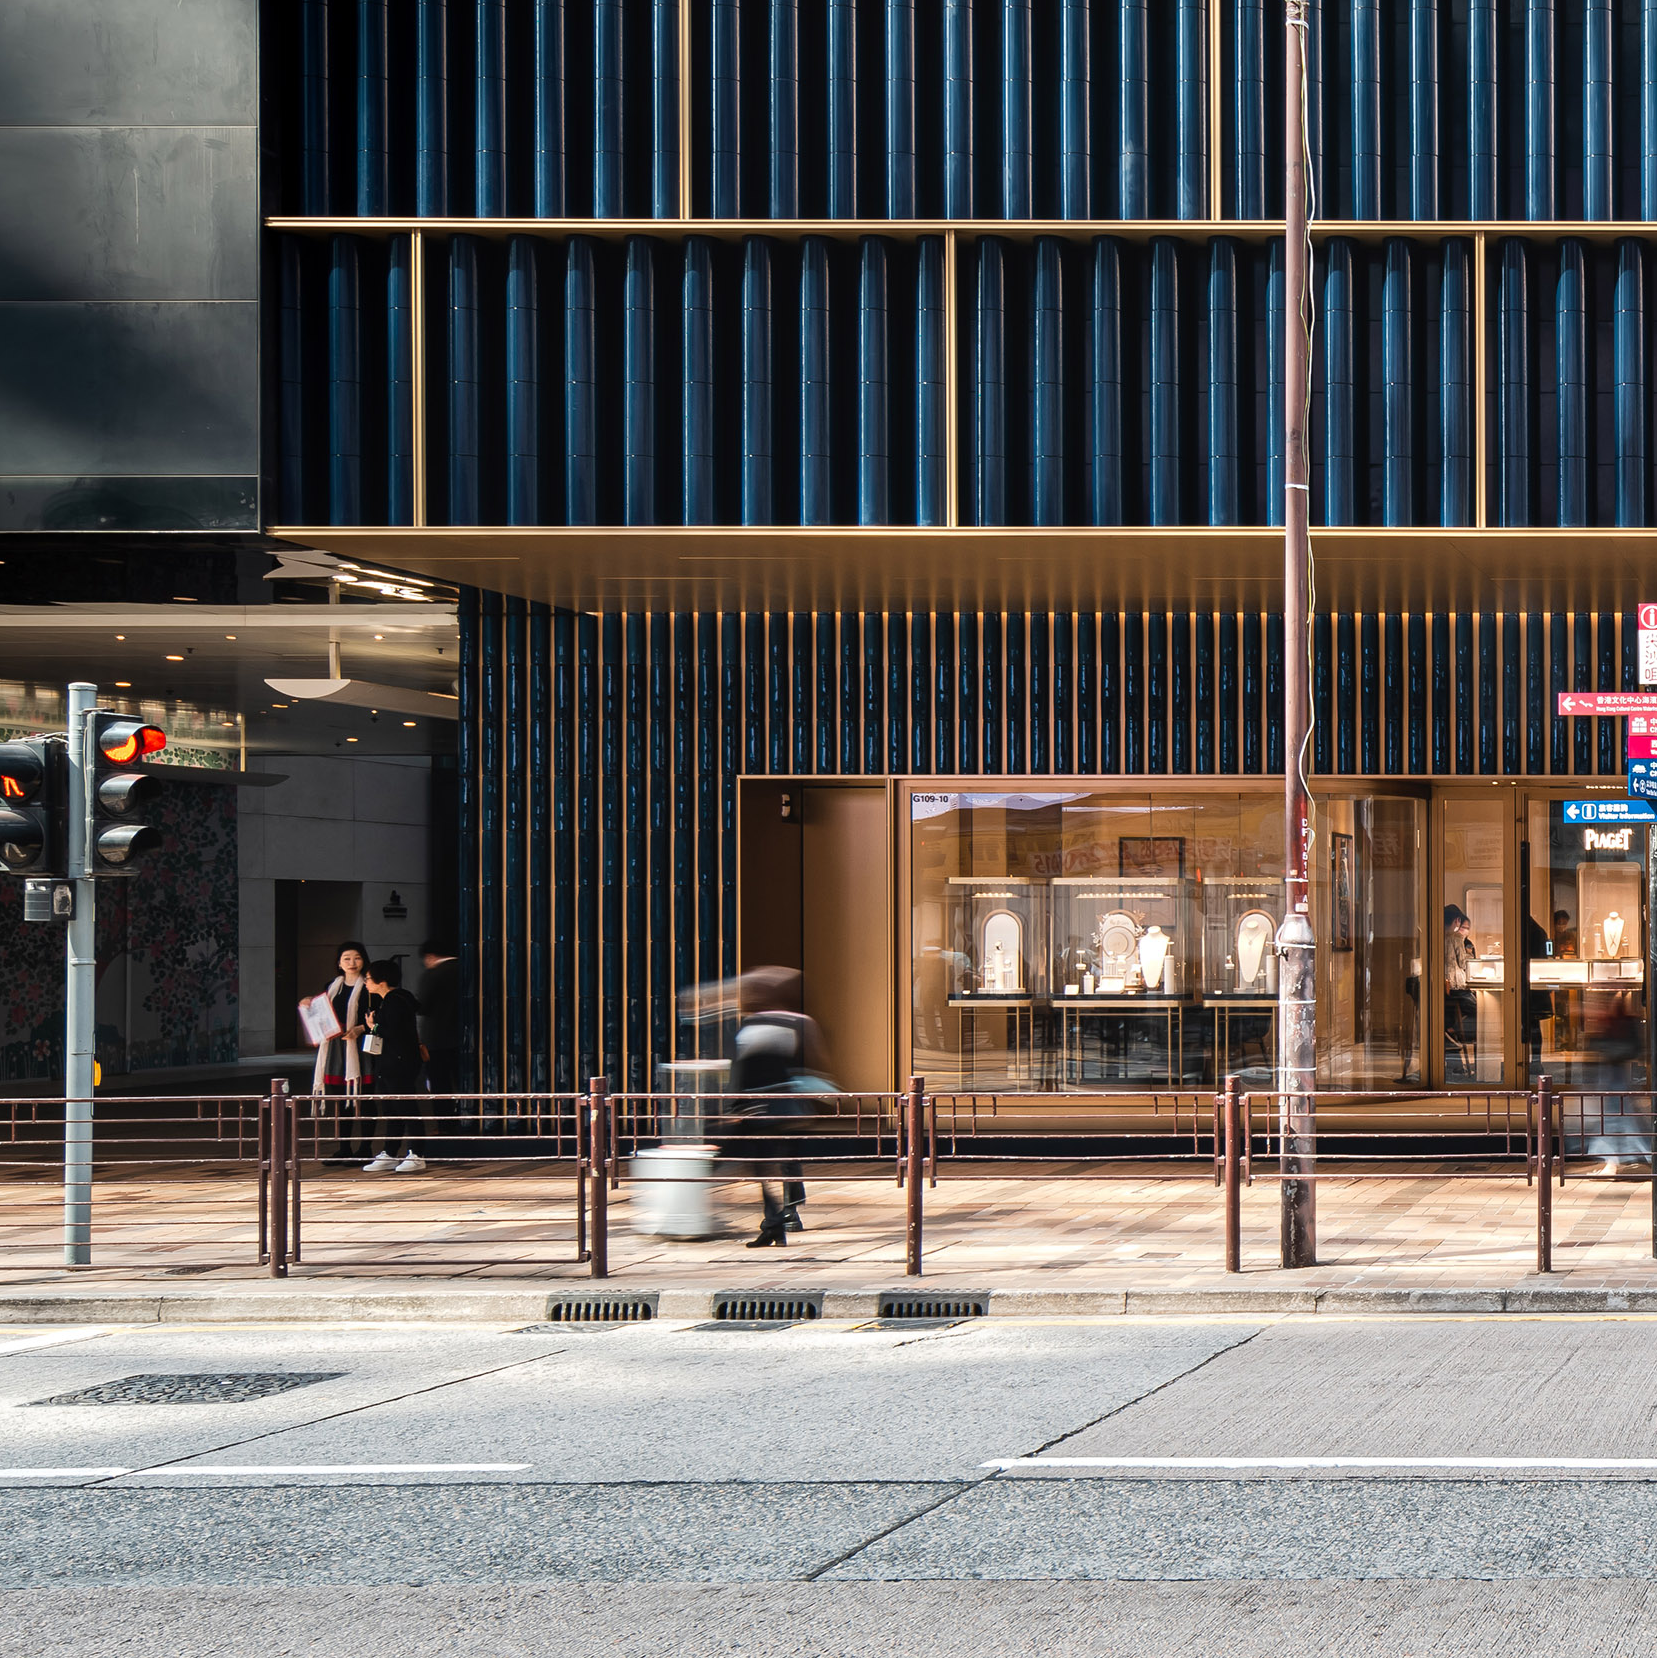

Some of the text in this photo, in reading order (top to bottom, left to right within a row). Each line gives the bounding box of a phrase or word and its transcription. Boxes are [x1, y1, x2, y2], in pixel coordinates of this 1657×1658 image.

[913, 795, 949, 803] G109-10
[1598, 812, 1618, 820] Visitor
[1585, 828, 1633, 851] PIAGET
